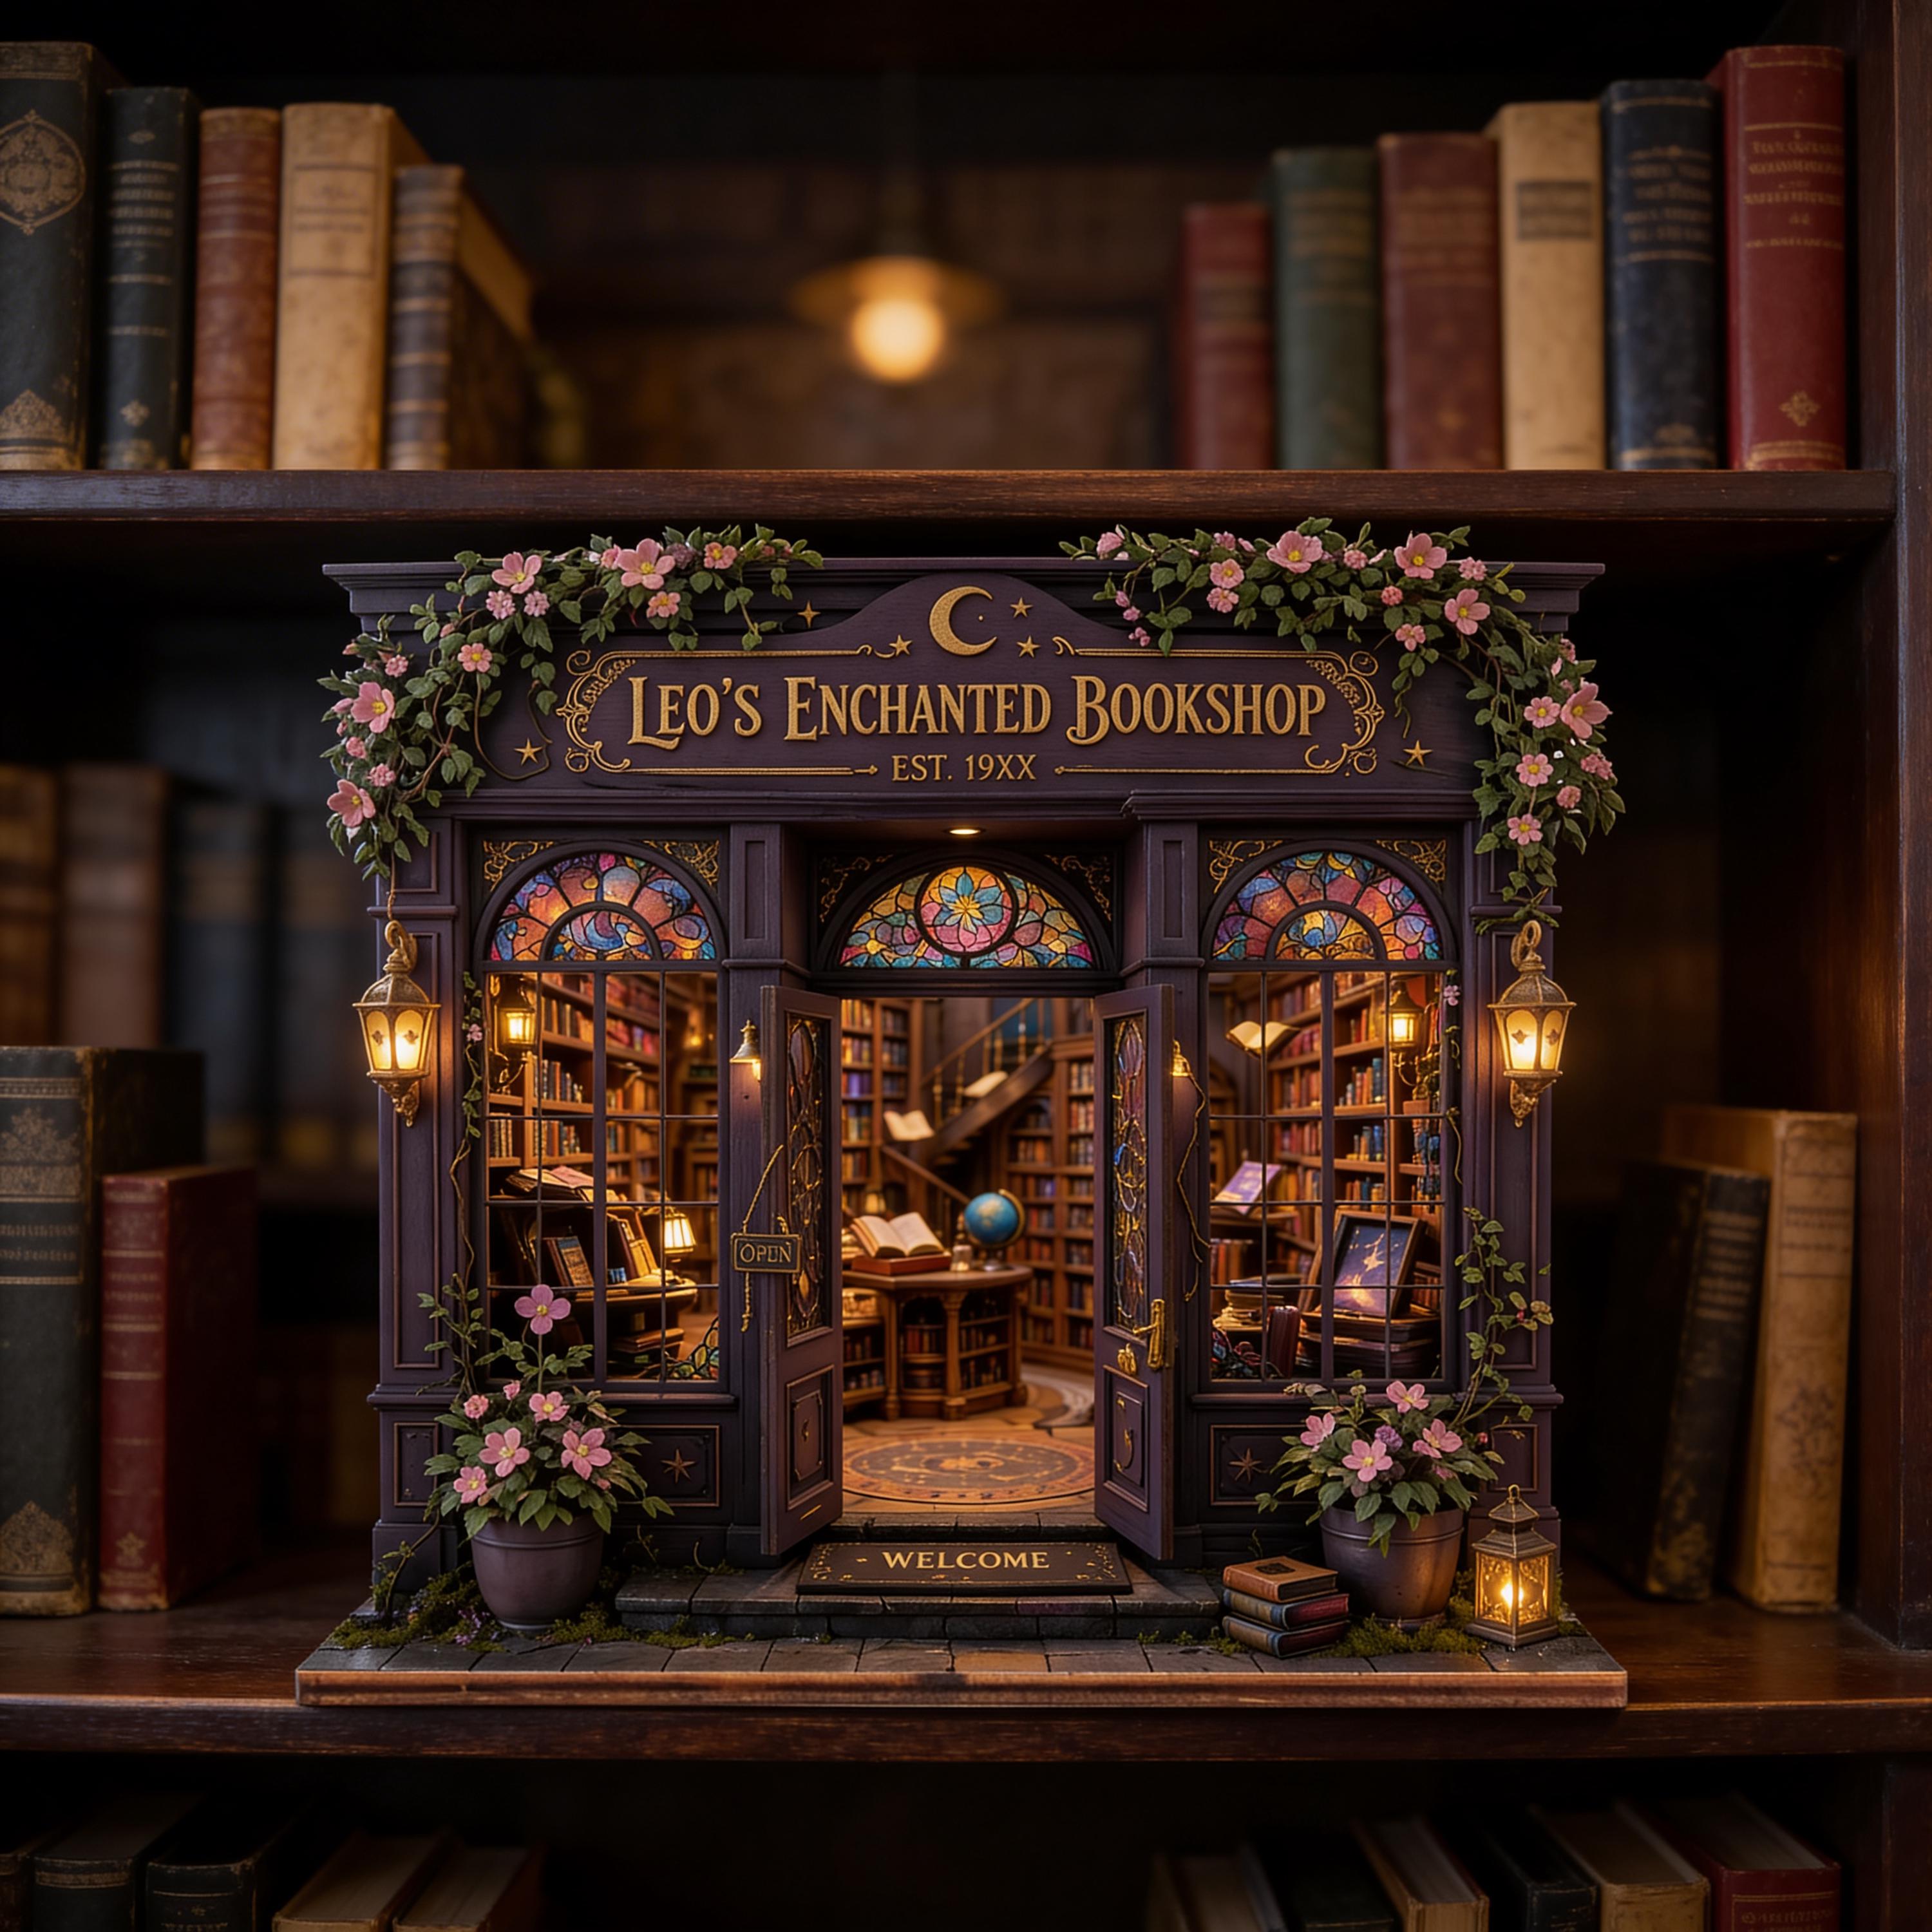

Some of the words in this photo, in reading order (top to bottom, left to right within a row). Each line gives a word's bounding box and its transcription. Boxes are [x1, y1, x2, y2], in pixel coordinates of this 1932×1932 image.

[627, 676, 762, 750] LEO'S
[783, 677, 1052, 741] ENCHANTED
[1066, 676, 1326, 745] BOOKSHOP
[891, 753, 953, 781] EST.
[965, 753, 1037, 781] 19XX
[882, 1551, 1050, 1569] WELCOME
